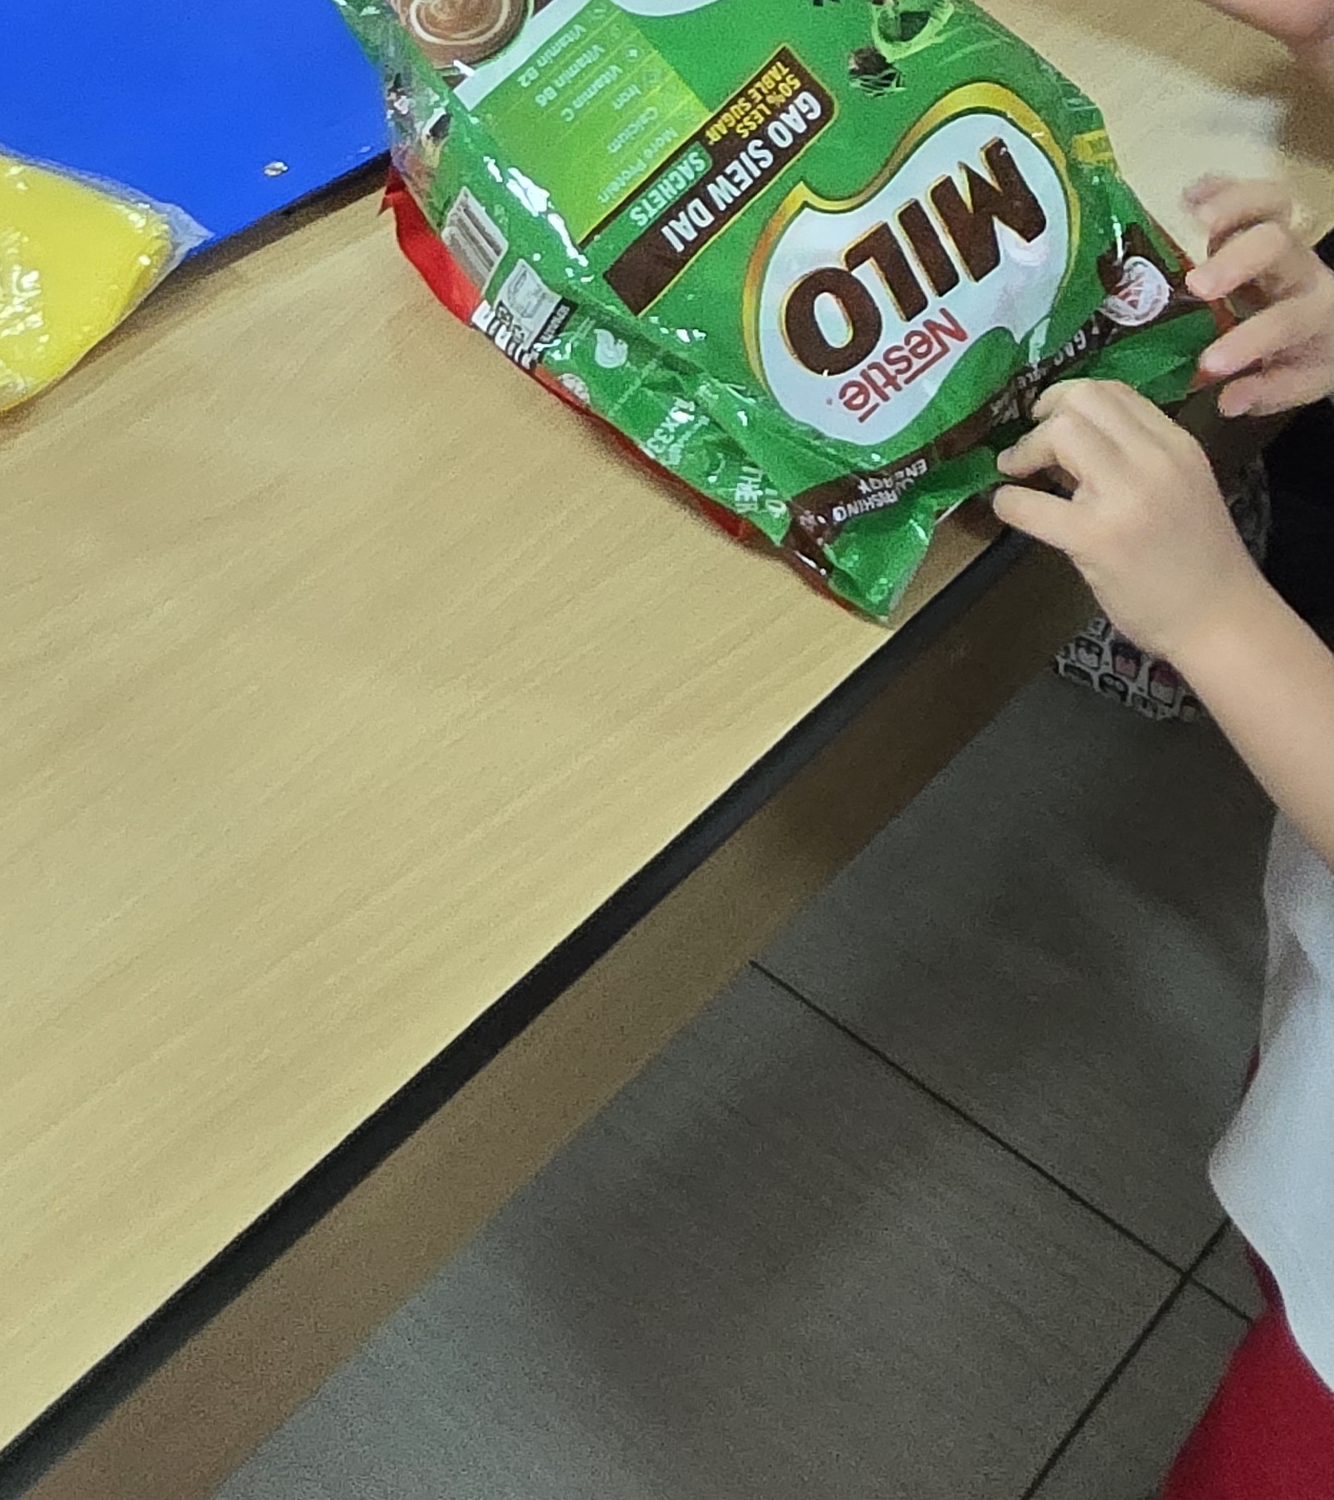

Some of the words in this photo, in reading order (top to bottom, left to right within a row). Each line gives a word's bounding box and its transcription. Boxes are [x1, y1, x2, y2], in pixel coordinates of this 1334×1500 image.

[536, 24, 586, 67] Vitamin
[553, 44, 606, 88] Vitamin
[517, 66, 539, 88] B2
[572, 64, 623, 110] Vitamin
[612, 84, 642, 110] Iron
[748, 61, 790, 100] TABLE
[766, 73, 801, 107] 50%
[560, 107, 575, 122] C
[607, 106, 659, 154] Calcium
[735, 103, 772, 139] LESS
[768, 91, 822, 148] GAO
[643, 126, 679, 159] More
[598, 158, 647, 204] Protein
[629, 151, 706, 227] SACHETS
[707, 140, 774, 211] SIEW
[661, 198, 715, 252] DAI
[778, 136, 1047, 377] MILO
